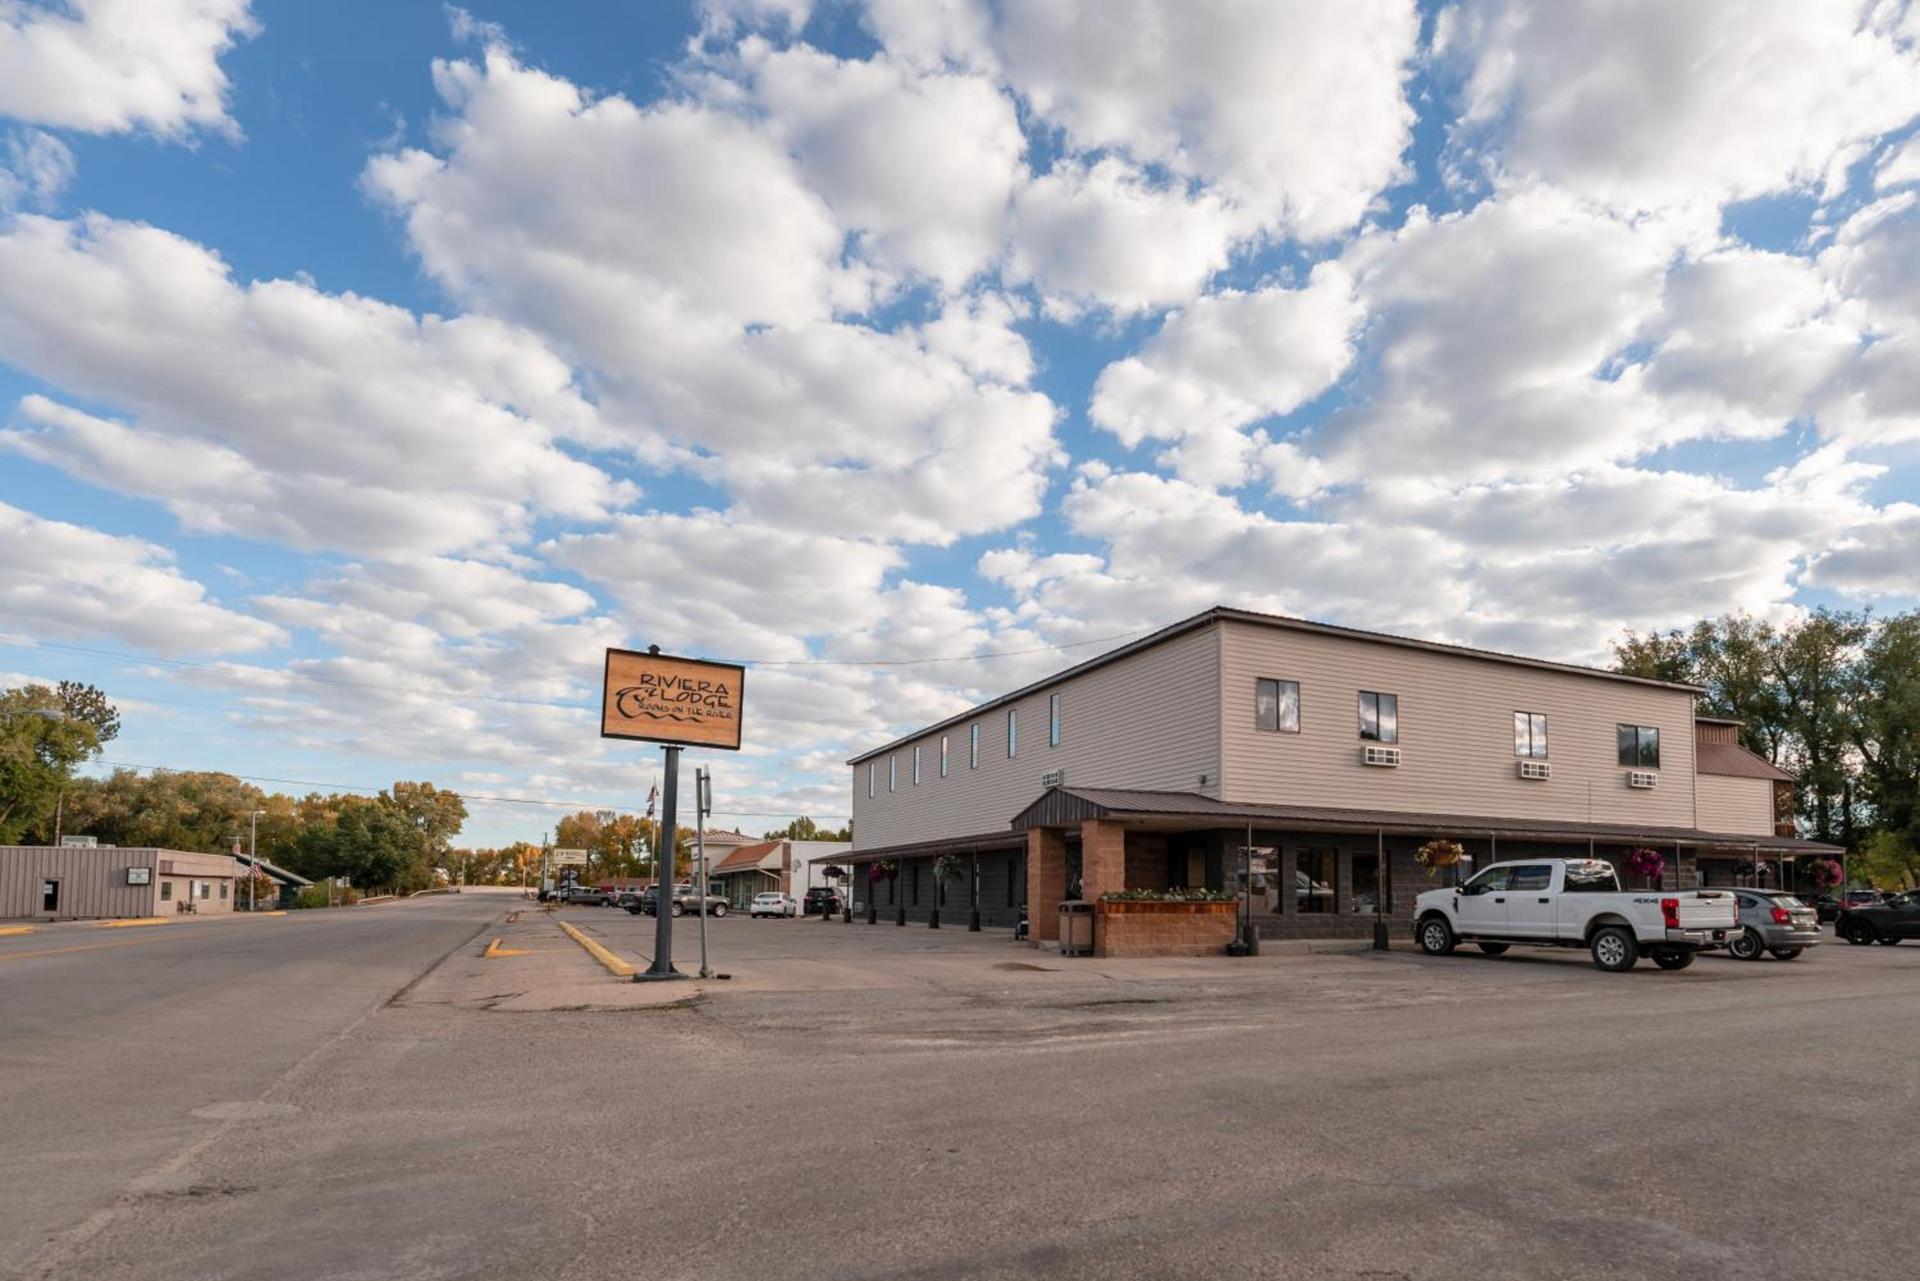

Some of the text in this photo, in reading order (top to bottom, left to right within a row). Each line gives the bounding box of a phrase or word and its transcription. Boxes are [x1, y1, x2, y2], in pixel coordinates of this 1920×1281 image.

[640, 674, 729, 695] RIVIERA
[661, 689, 732, 708] LODGE
[672, 705, 684, 713] ON
[706, 709, 732, 719] RIVER
